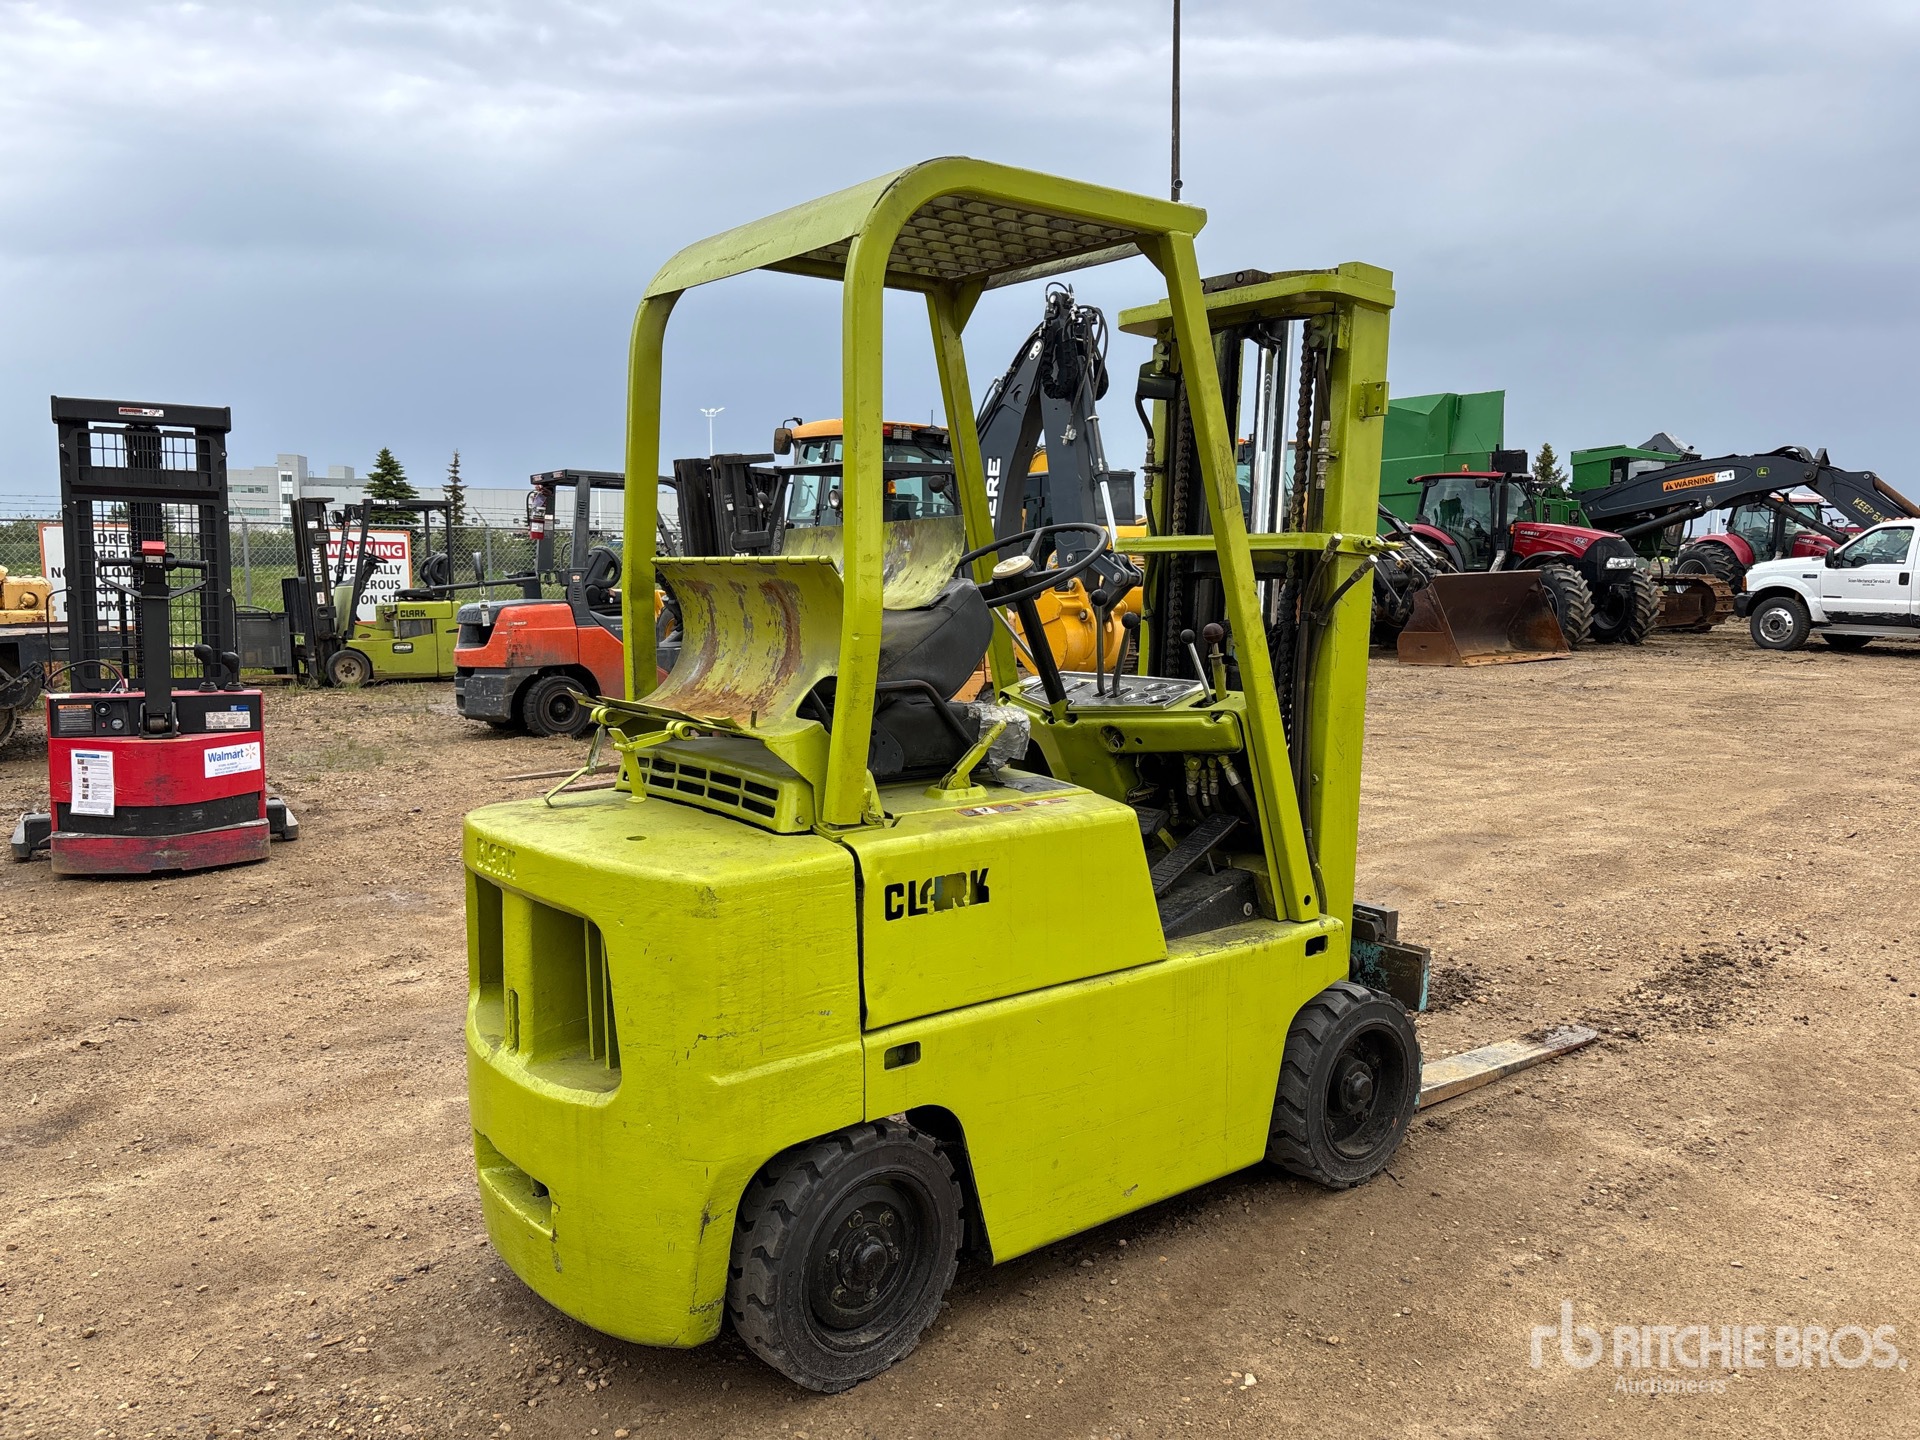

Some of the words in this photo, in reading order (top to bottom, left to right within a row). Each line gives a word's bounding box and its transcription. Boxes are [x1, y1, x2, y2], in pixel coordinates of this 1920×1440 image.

[986, 457, 1001, 530] ERE
[1674, 475, 1716, 489] WARNING
[1852, 497, 1875, 515] KEEP
[1871, 511, 1885, 524] BA
[311, 547, 322, 574] CLARK
[400, 609, 426, 618] CLARK
[208, 748, 244, 763] Walmart
[884, 867, 990, 921] CLARK
